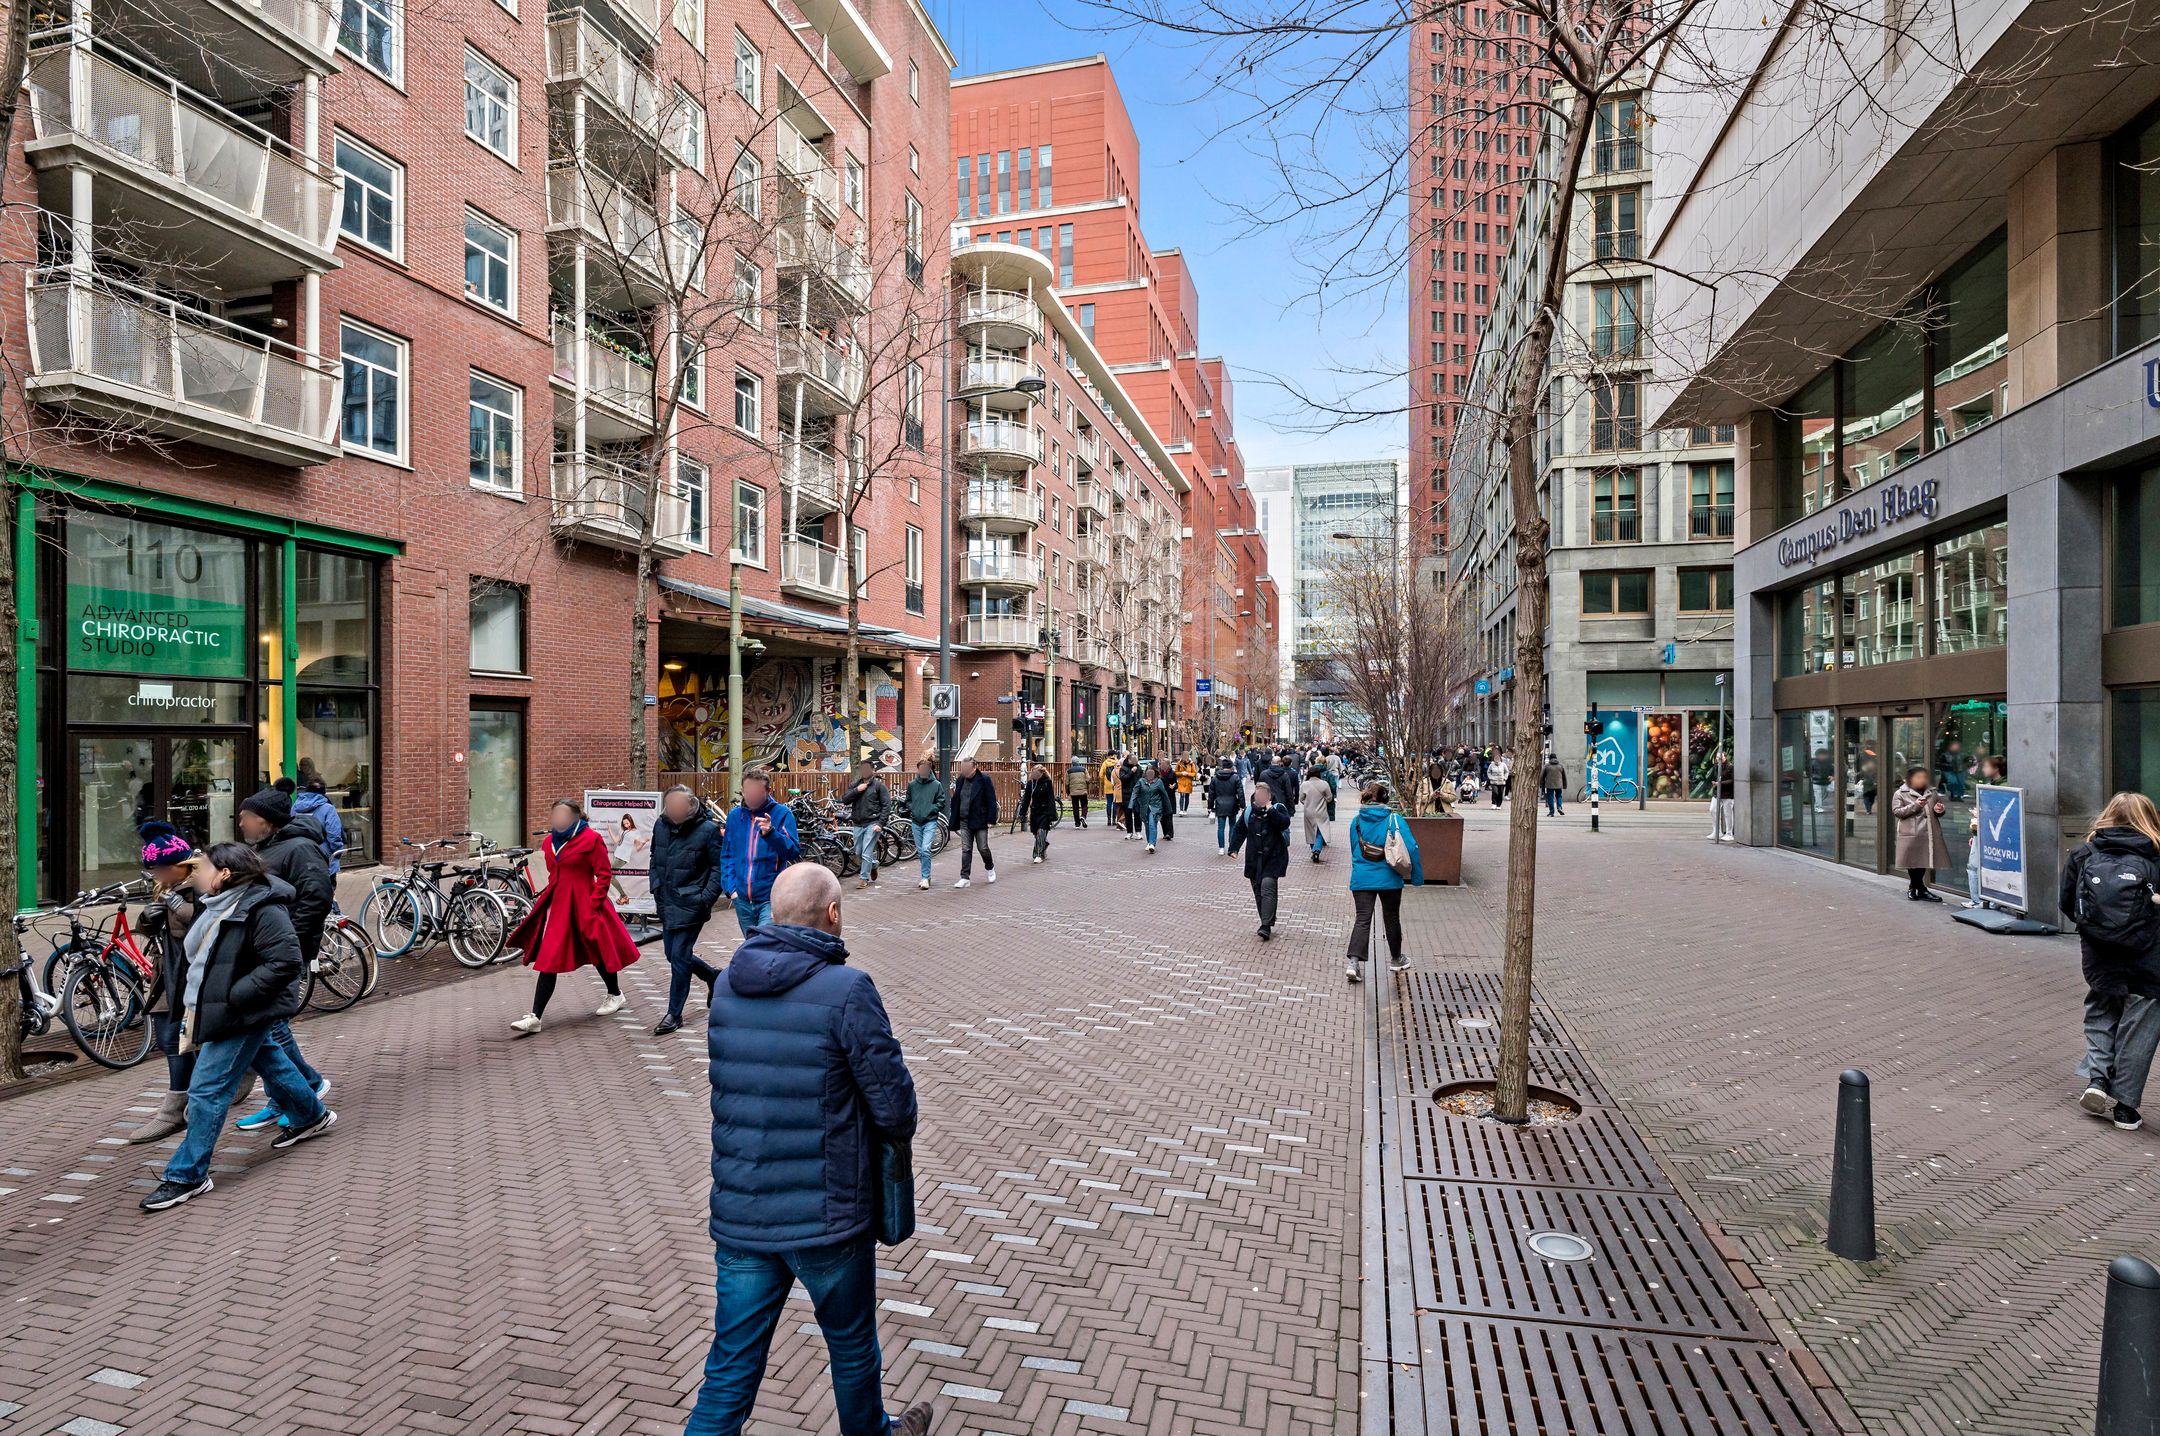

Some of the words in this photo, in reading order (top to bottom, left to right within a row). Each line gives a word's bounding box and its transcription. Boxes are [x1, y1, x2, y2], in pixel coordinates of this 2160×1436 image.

[1778, 525, 1837, 567] Campus
[1838, 506, 1876, 542] Den
[1881, 478, 1938, 523] Haag
[116, 534, 203, 584] 110
[82, 603, 189, 628] ADVANCED
[82, 620, 220, 647] CHIROPRACTIC
[82, 637, 155, 656] STUDIO
[128, 692, 217, 709] chiropractor
[823, 665, 834, 715] CHUCK
[592, 800, 624, 808] Chiropractic
[1983, 845, 2019, 861] ROOKVRIJ
